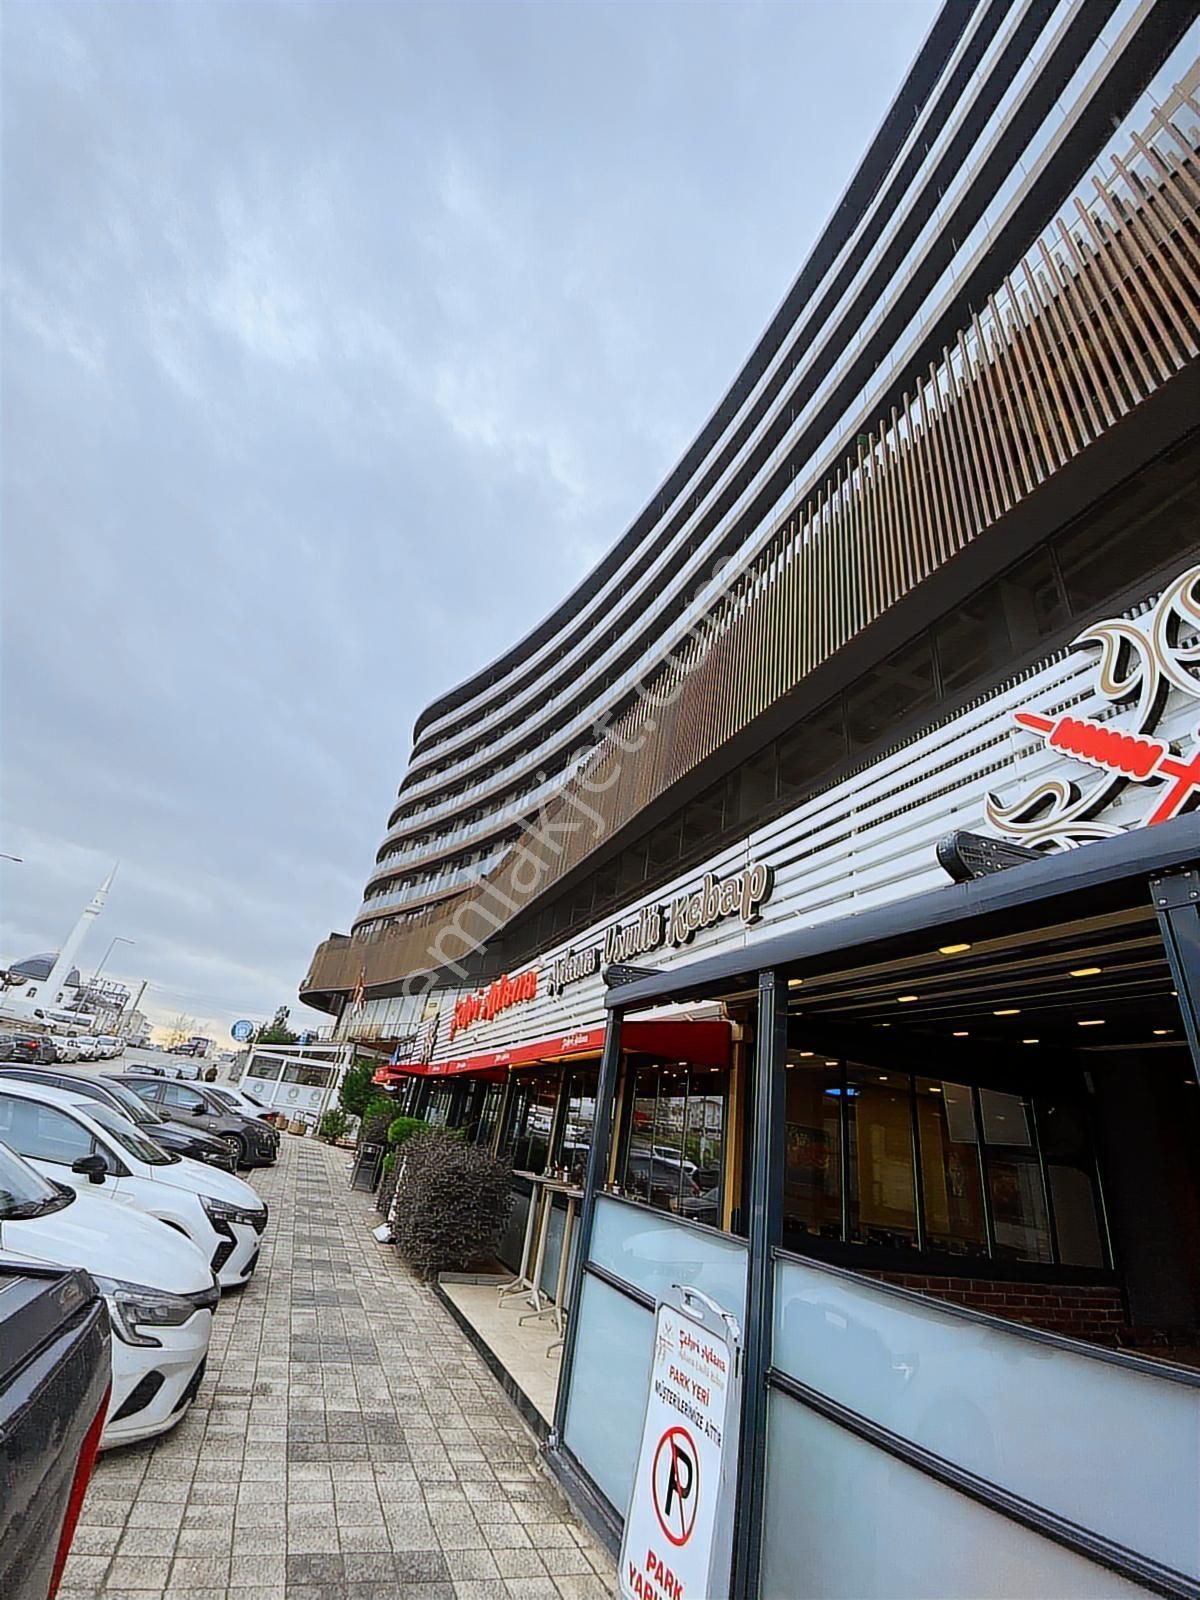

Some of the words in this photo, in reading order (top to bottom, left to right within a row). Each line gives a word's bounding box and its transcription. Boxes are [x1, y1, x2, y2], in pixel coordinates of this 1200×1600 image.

[668, 863, 773, 947] Kebap
[669, 1364, 691, 1393] PARK
[691, 1379, 710, 1407] YERİ
[646, 1549, 684, 1600] PARK
